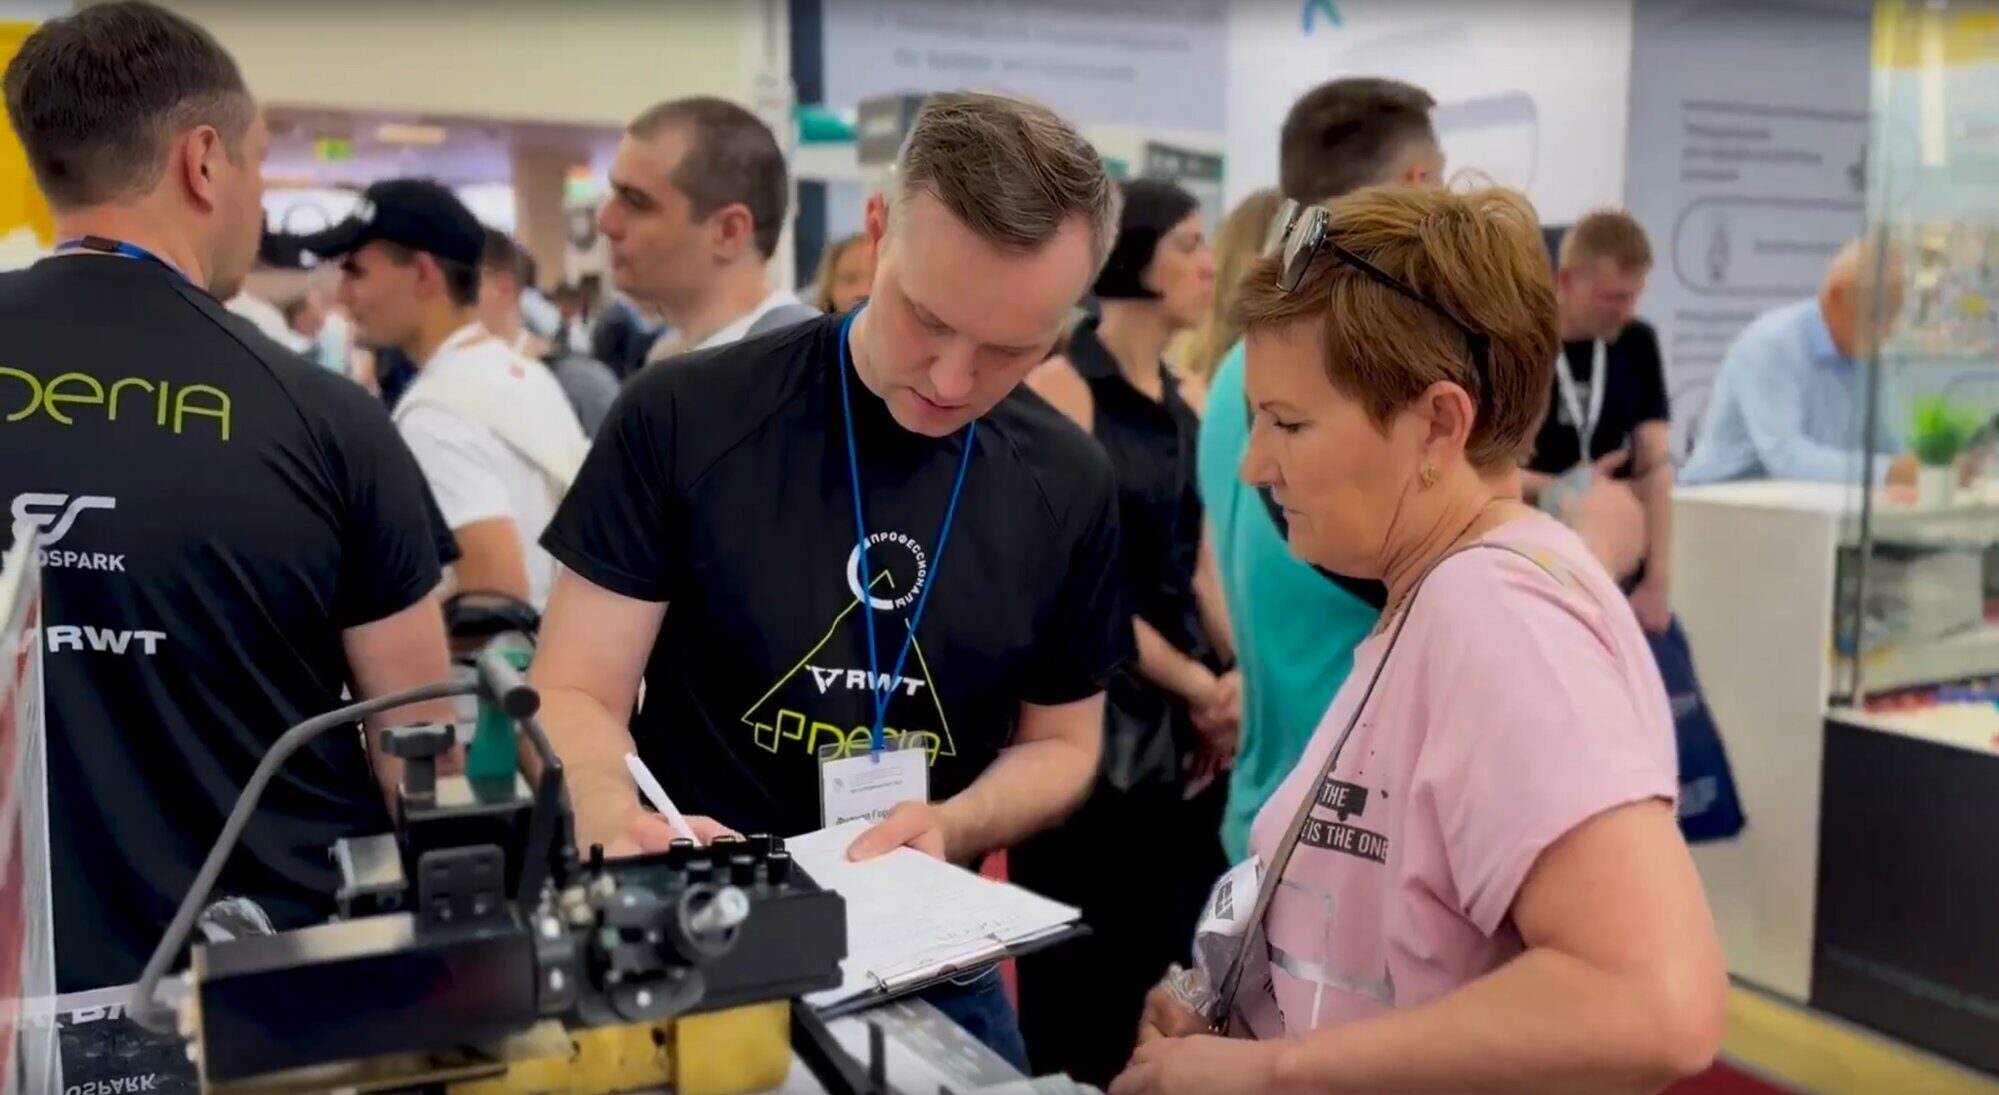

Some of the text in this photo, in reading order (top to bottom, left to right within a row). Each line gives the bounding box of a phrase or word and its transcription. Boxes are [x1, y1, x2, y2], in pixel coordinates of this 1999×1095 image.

[870, 531, 927, 609] ПРОФЕССИОНАЛЫ
[46, 625, 166, 655] RWT
[846, 669, 925, 696] RWT
[1321, 783, 1350, 808] THE
[1306, 821, 1321, 842] IS
[1327, 825, 1353, 850] THE
[1358, 834, 1389, 860] ONE
